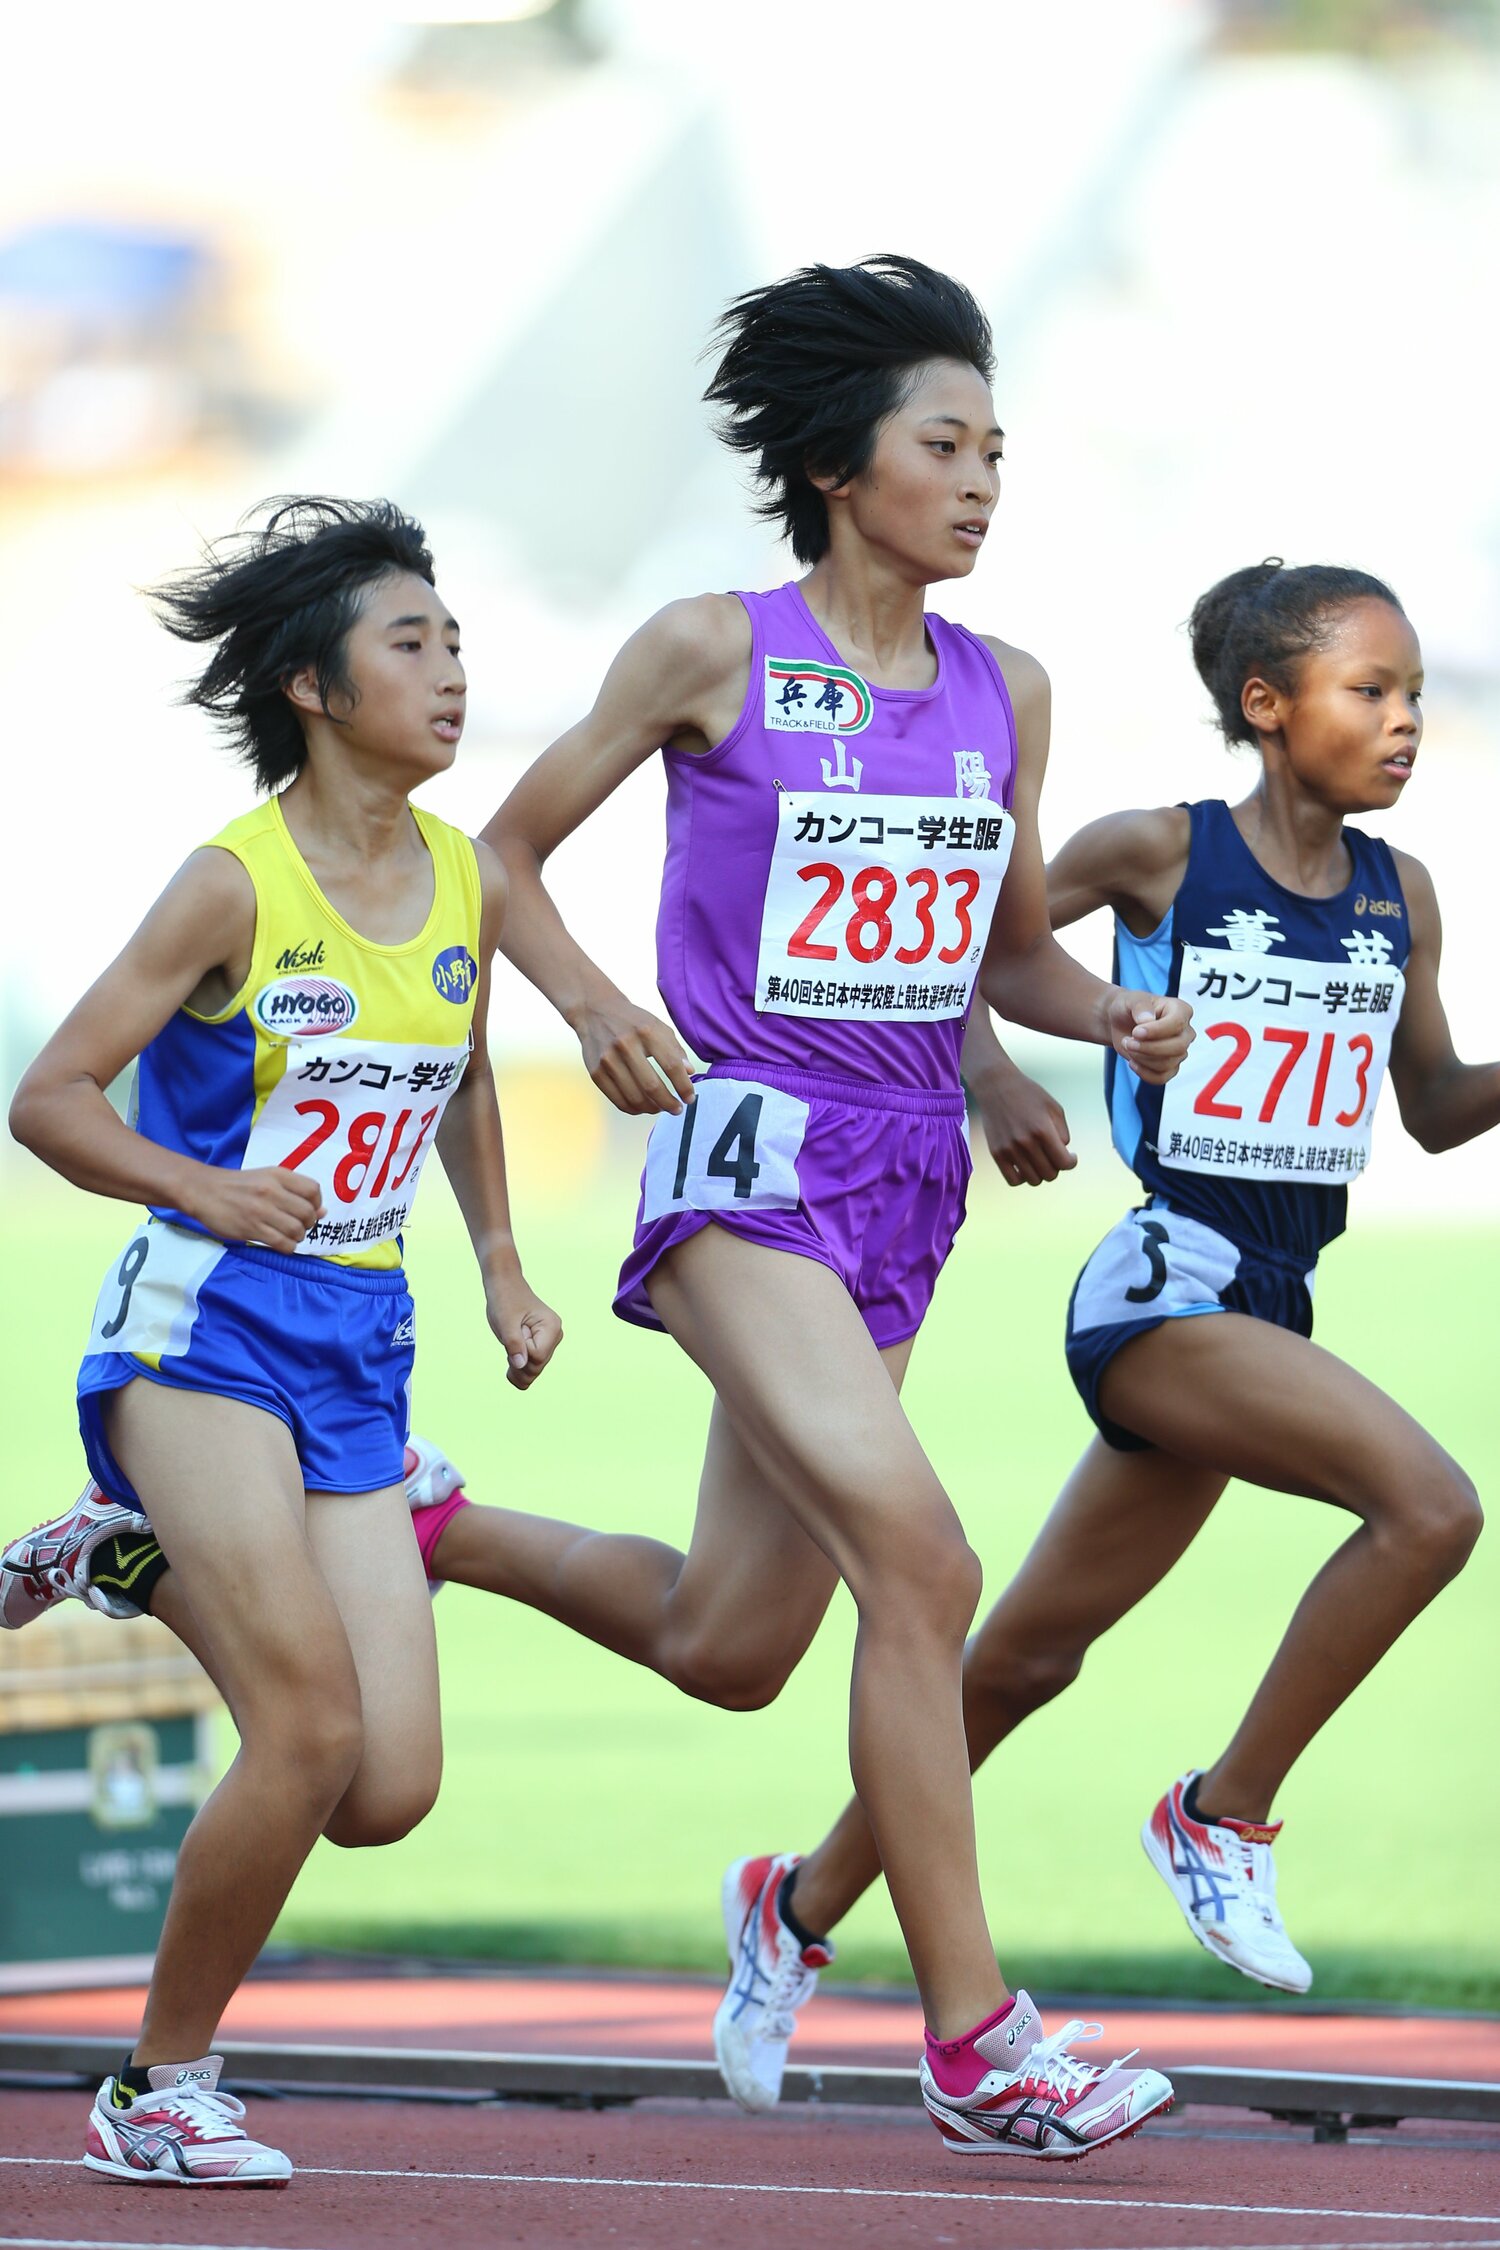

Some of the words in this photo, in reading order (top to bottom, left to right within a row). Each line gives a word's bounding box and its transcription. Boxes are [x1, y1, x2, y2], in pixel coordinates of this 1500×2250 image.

[775, 677, 844, 722] 兵庫
[771, 716, 835, 731] TRACK&FIELD
[794, 810, 1003, 851] カンコー学生服
[787, 862, 980, 965] 2833
[271, 991, 346, 1016] HYOGO
[767, 975, 967, 1011] 第40回全日本中学校陸上競技選手権大会
[1196, 967, 1394, 1014] カンコー学生服
[264, 1017, 302, 1025] TRACK
[1193, 1021, 1374, 1127] 2713
[672, 1093, 764, 1200] 14
[1169, 1131, 1366, 1175] 第40回全日本中学校陸上競技選手権大会
[101, 1236, 149, 1339] 9
[188, 2069, 211, 2082] asics
